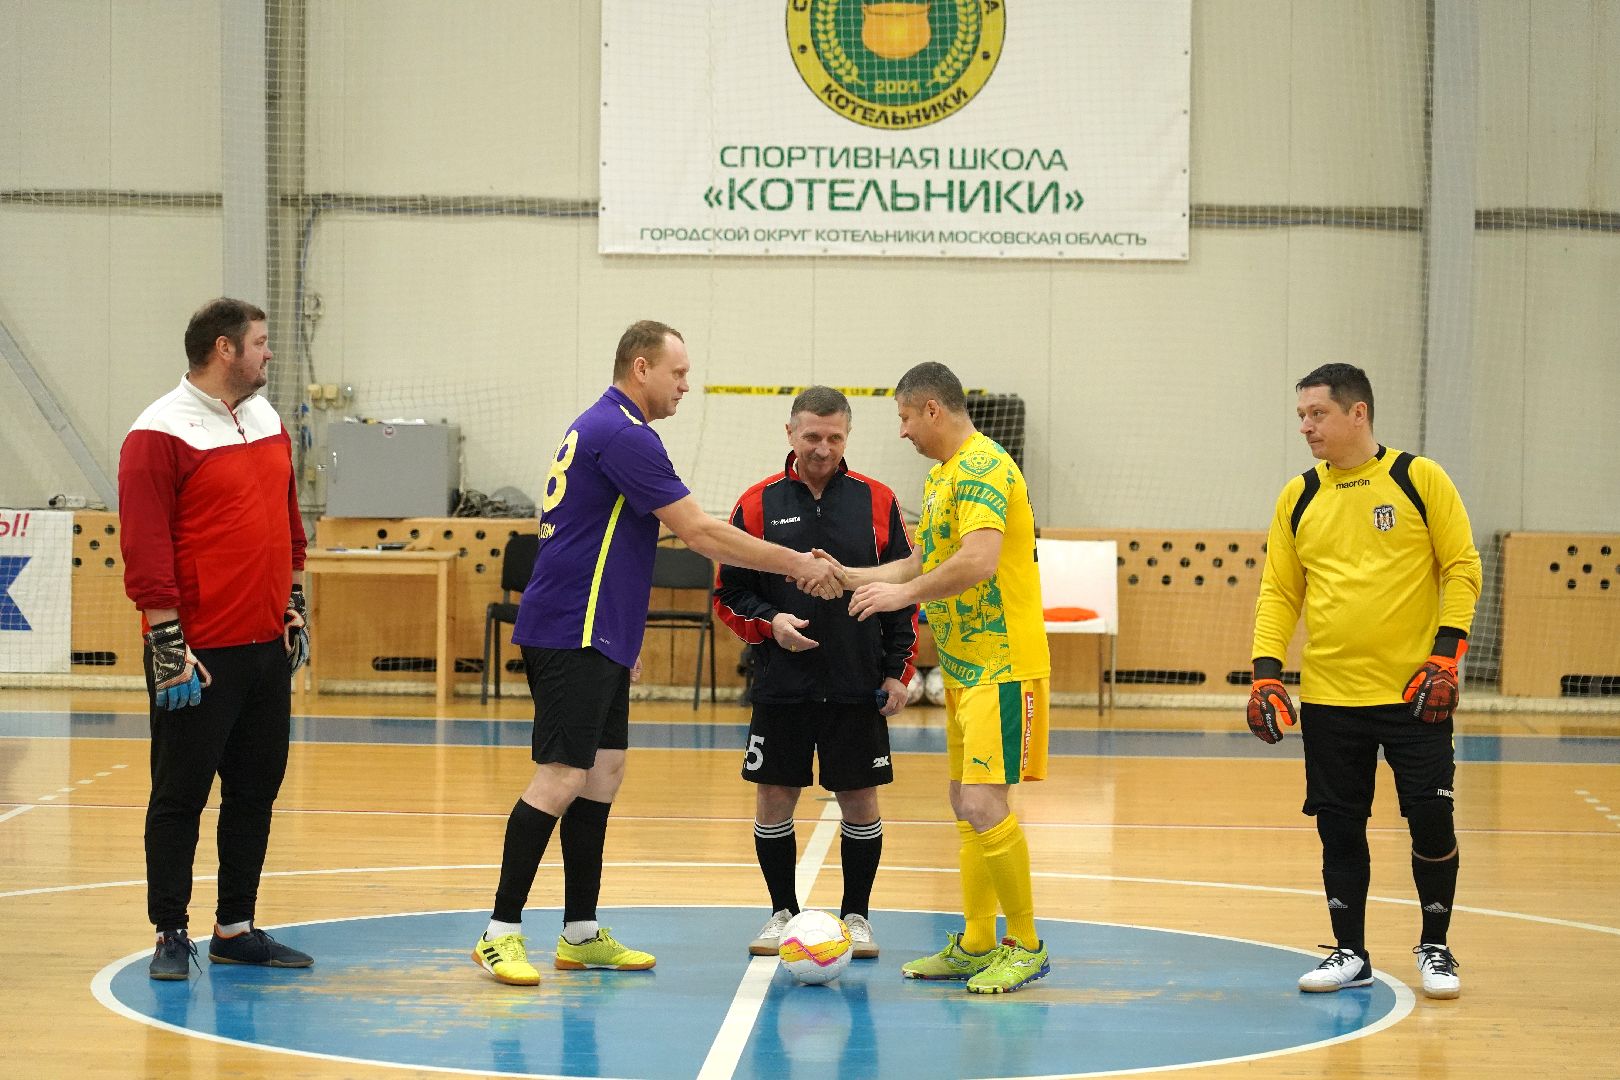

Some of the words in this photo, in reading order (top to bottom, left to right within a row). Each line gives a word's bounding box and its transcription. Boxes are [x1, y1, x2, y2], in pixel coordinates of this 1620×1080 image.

[874, 80, 920, 94] 2001
[821, 83, 968, 126] КОТЕЛЬНИКИ
[719, 146, 939, 170] СПОРТИВНАЯ
[948, 148, 1069, 172] ШКОЛА
[703, 177, 1084, 214] «КОТЕЛЬНИКИ»
[640, 227, 749, 242] ГОРОДСКОЙ
[754, 229, 813, 242] ОКРУГ
[815, 229, 935, 243] КОТЕЛЬНИКИ
[938, 231, 1061, 244] МОСКОВСКАЯ
[1065, 232, 1147, 246] ОБЛАСТЬ
[542, 429, 579, 513] 8
[1335, 478, 1370, 490] macron
